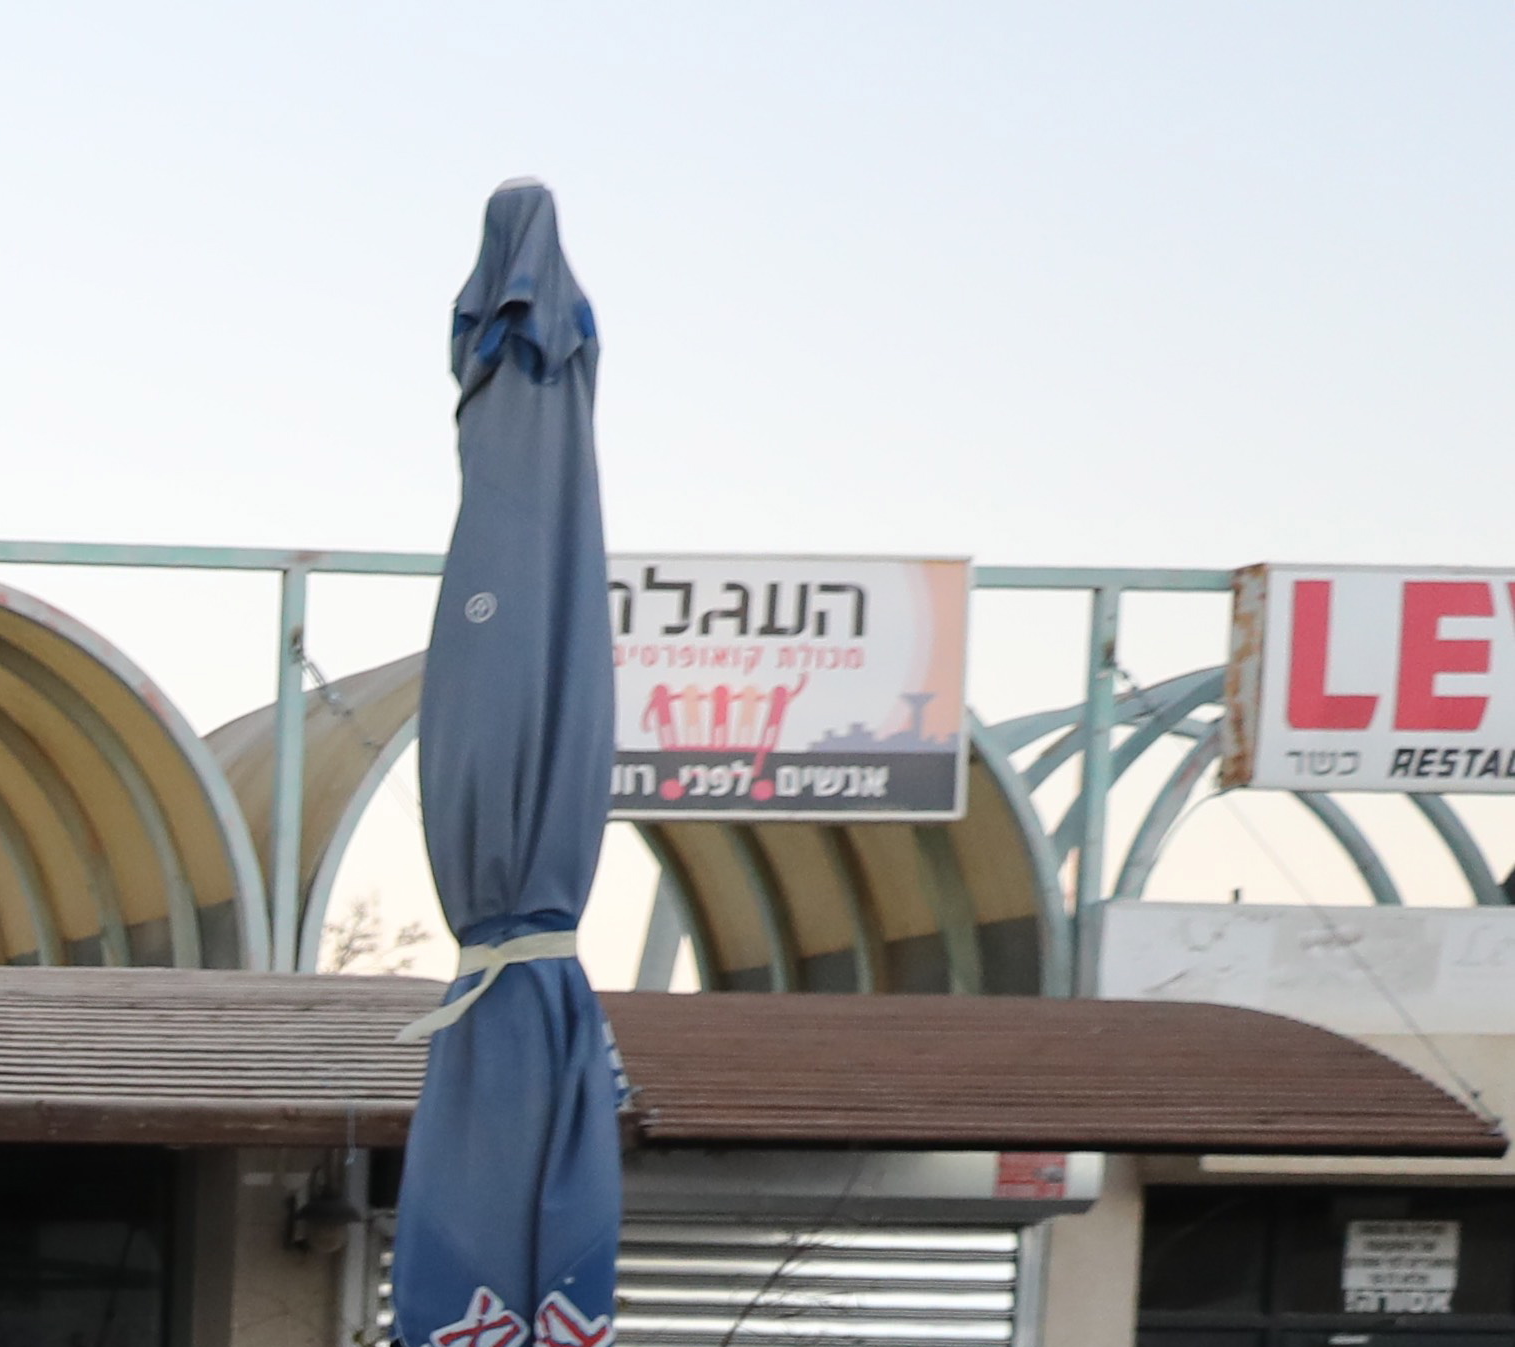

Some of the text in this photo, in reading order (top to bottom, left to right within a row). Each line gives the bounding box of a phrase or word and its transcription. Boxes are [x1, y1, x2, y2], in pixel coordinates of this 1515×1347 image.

[1287, 579, 1515, 731] LE
[679, 760, 755, 797] לפני
[1286, 751, 1359, 775] כשר
[775, 767, 888, 798] אנשים
